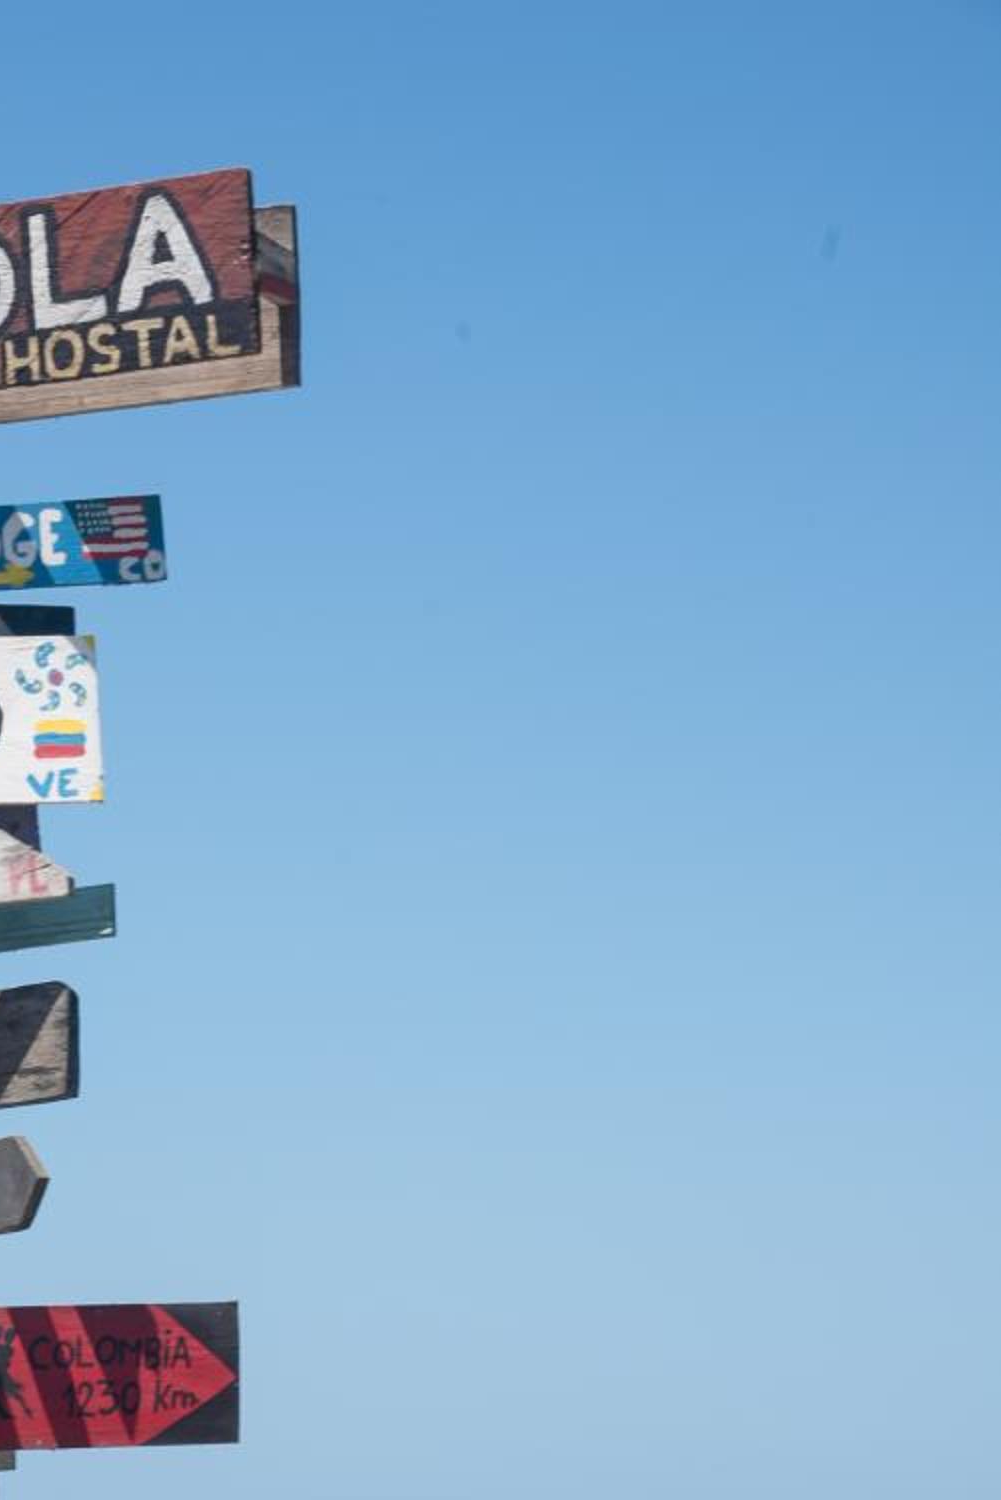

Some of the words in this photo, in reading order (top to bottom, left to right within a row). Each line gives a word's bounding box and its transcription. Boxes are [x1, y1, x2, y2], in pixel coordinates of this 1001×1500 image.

[2, 314, 245, 386] HOSTAL
[118, 550, 166, 582] CO
[26, 767, 80, 799] VE
